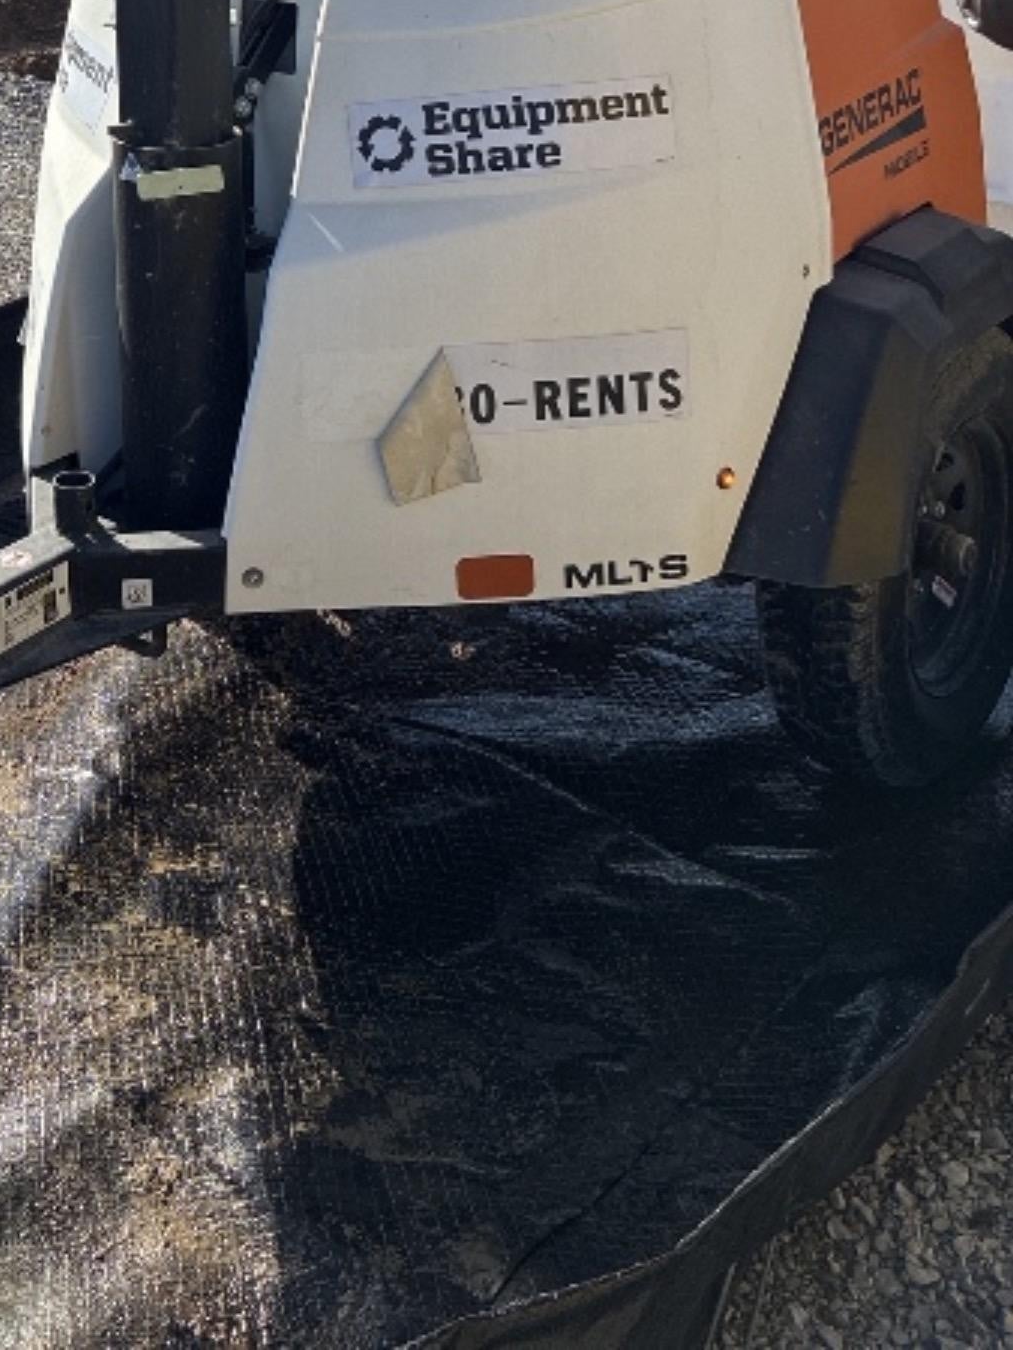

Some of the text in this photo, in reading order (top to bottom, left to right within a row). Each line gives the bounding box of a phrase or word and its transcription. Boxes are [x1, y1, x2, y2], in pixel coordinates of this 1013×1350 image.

[421, 83, 670, 140] Equipment
[818, 68, 922, 156] GENERAC
[424, 140, 562, 177] Share
[454, 368, 683, 425] 0-RENTS
